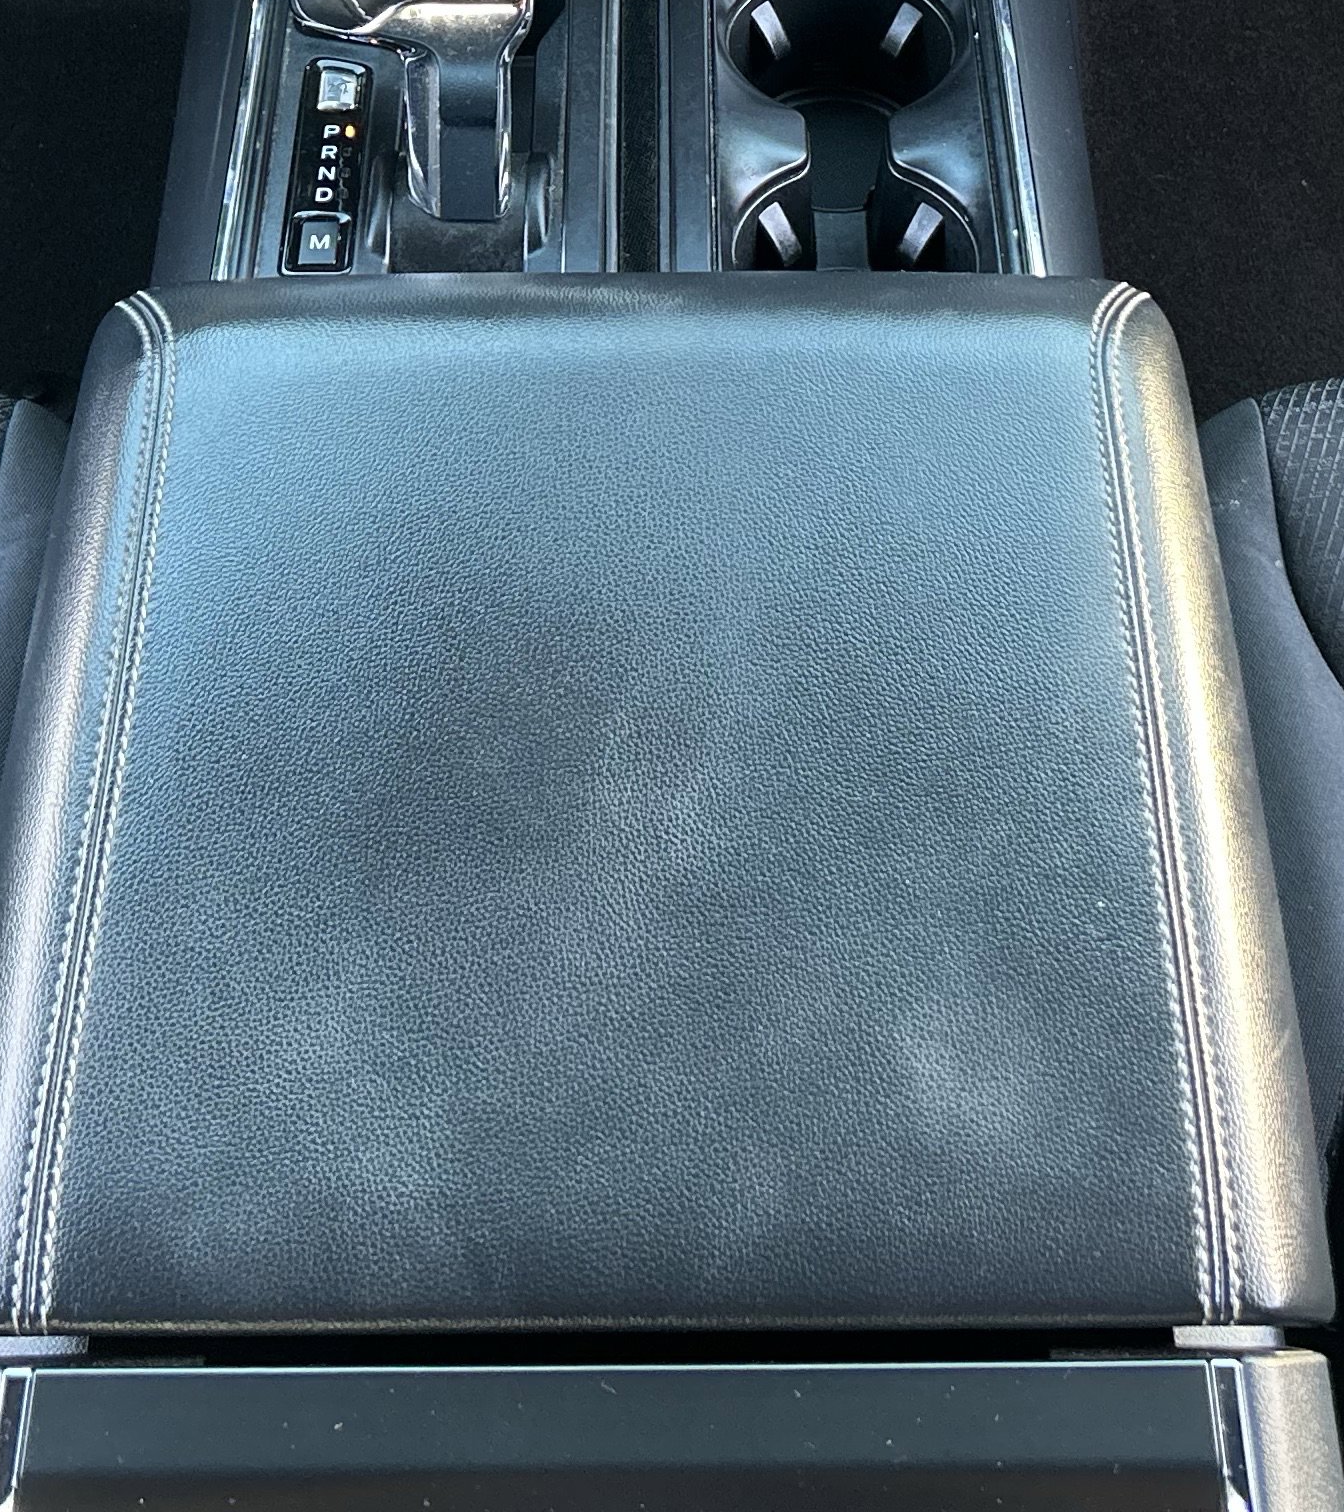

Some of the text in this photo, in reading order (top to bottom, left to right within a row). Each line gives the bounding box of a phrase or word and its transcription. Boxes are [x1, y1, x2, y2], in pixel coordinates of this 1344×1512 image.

[323, 124, 341, 139] P
[320, 144, 338, 160] R
[317, 166, 336, 181] N
[314, 187, 333, 203] D
[309, 234, 331, 250] M
